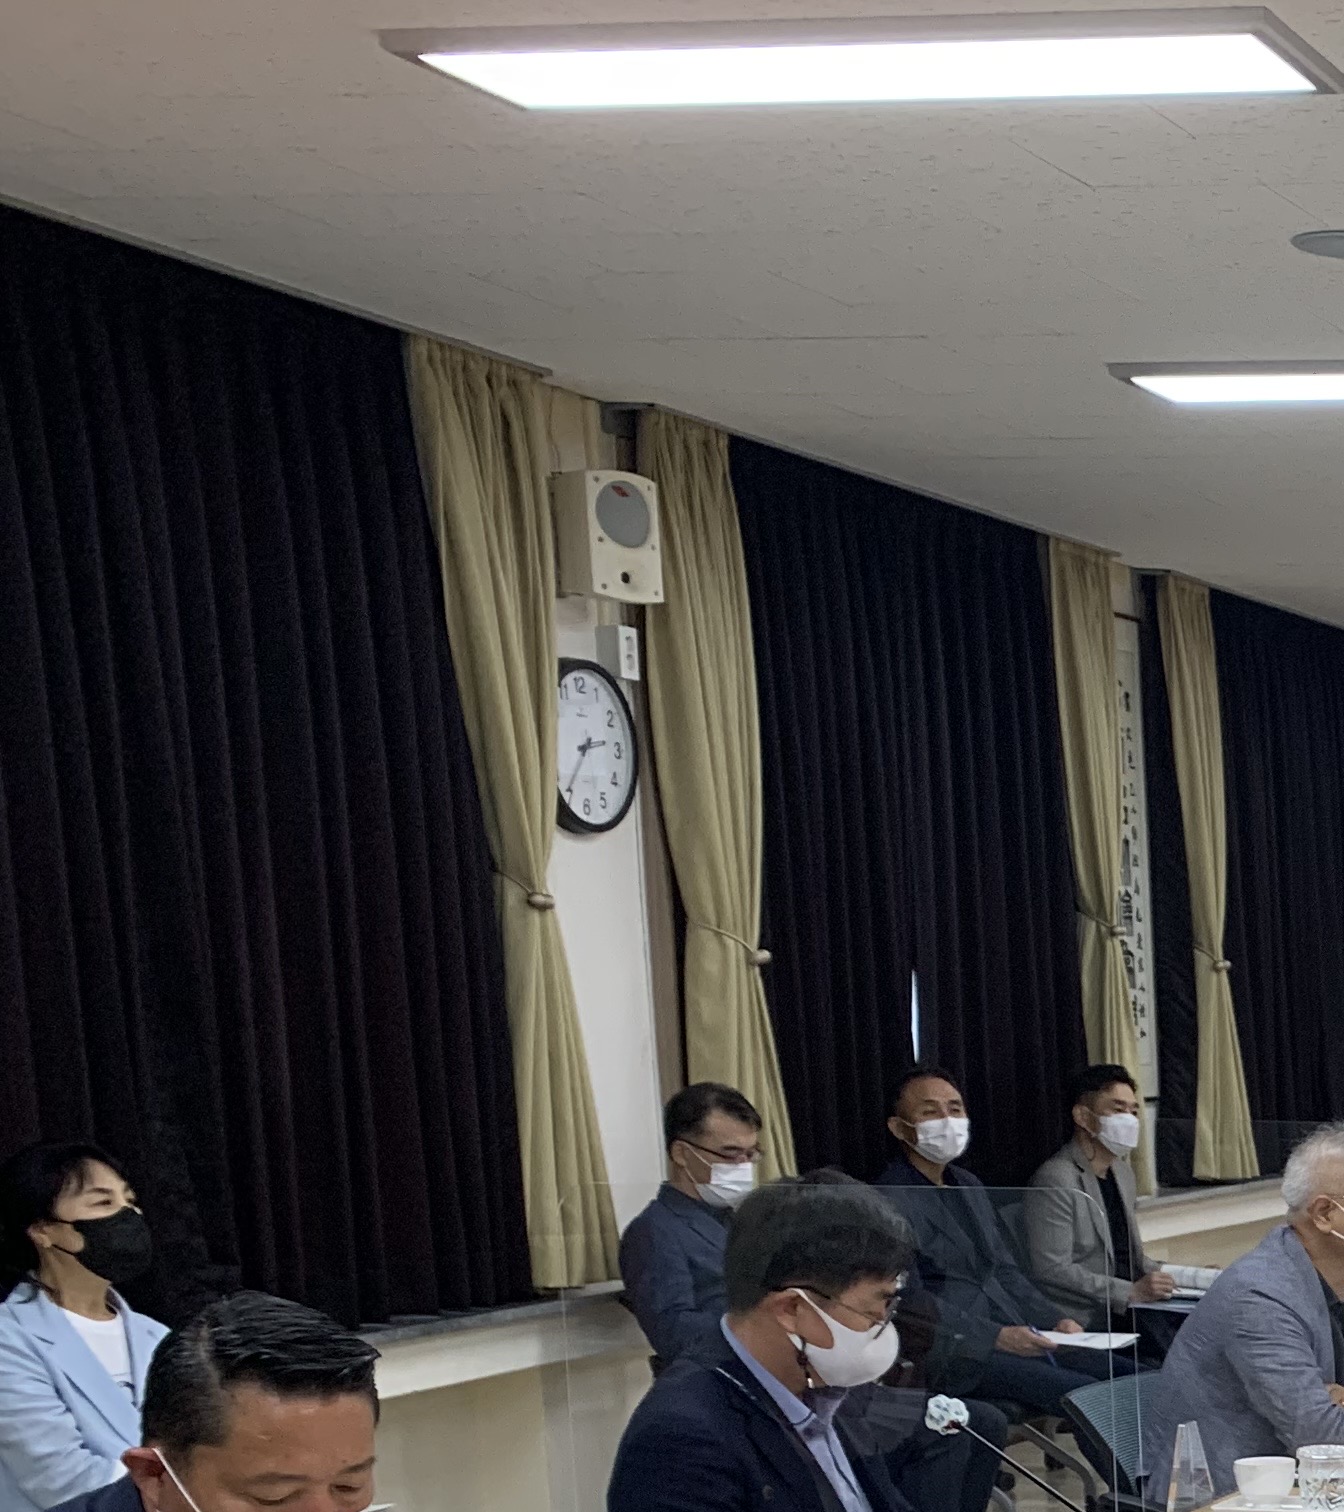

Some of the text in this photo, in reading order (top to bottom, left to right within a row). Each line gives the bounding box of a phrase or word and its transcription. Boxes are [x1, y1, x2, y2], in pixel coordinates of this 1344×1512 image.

[573, 676, 586, 694] 12
[607, 710, 614, 728] 2
[613, 742, 621, 759] 3
[610, 771, 618, 787] 4
[583, 798, 591, 816] 6
